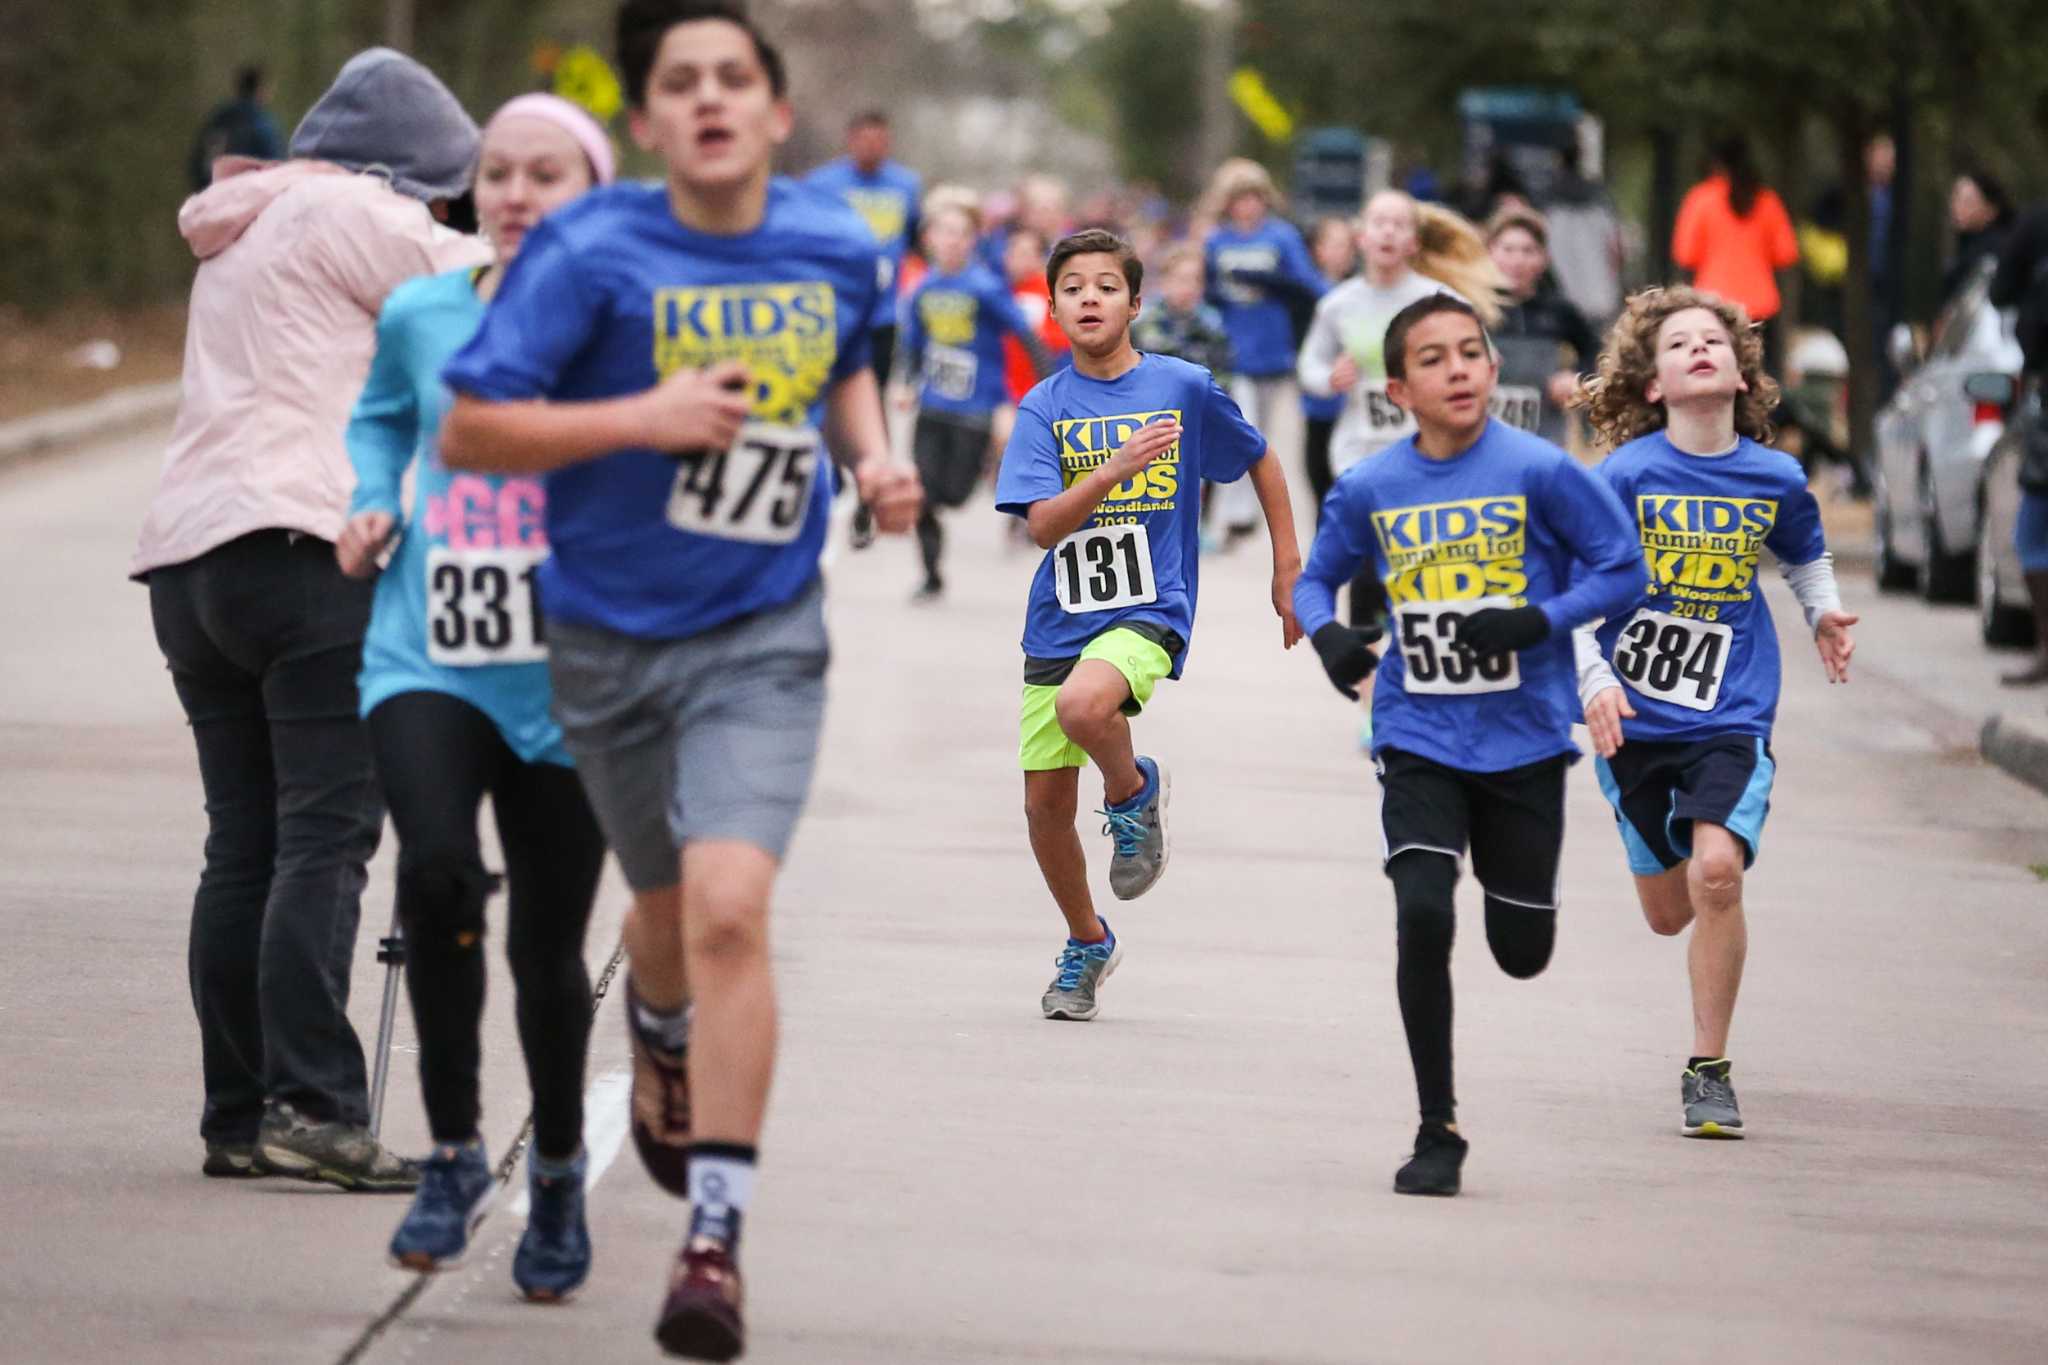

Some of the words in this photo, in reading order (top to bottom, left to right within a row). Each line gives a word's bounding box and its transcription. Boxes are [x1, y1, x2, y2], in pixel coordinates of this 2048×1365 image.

[665, 295, 826, 337] KIDS
[684, 440, 815, 528] 475
[1377, 501, 1523, 550] KIDS
[1642, 498, 1773, 536] KIDS
[1644, 530, 1739, 554] running
[1744, 532, 1761, 553] fo
[1059, 532, 1144, 604] 131
[1386, 558, 1529, 607] KIDS
[1645, 549, 1760, 590] KIDS
[433, 565, 547, 648] 331
[1669, 600, 1720, 622] 2018
[1616, 618, 1724, 701] 384
